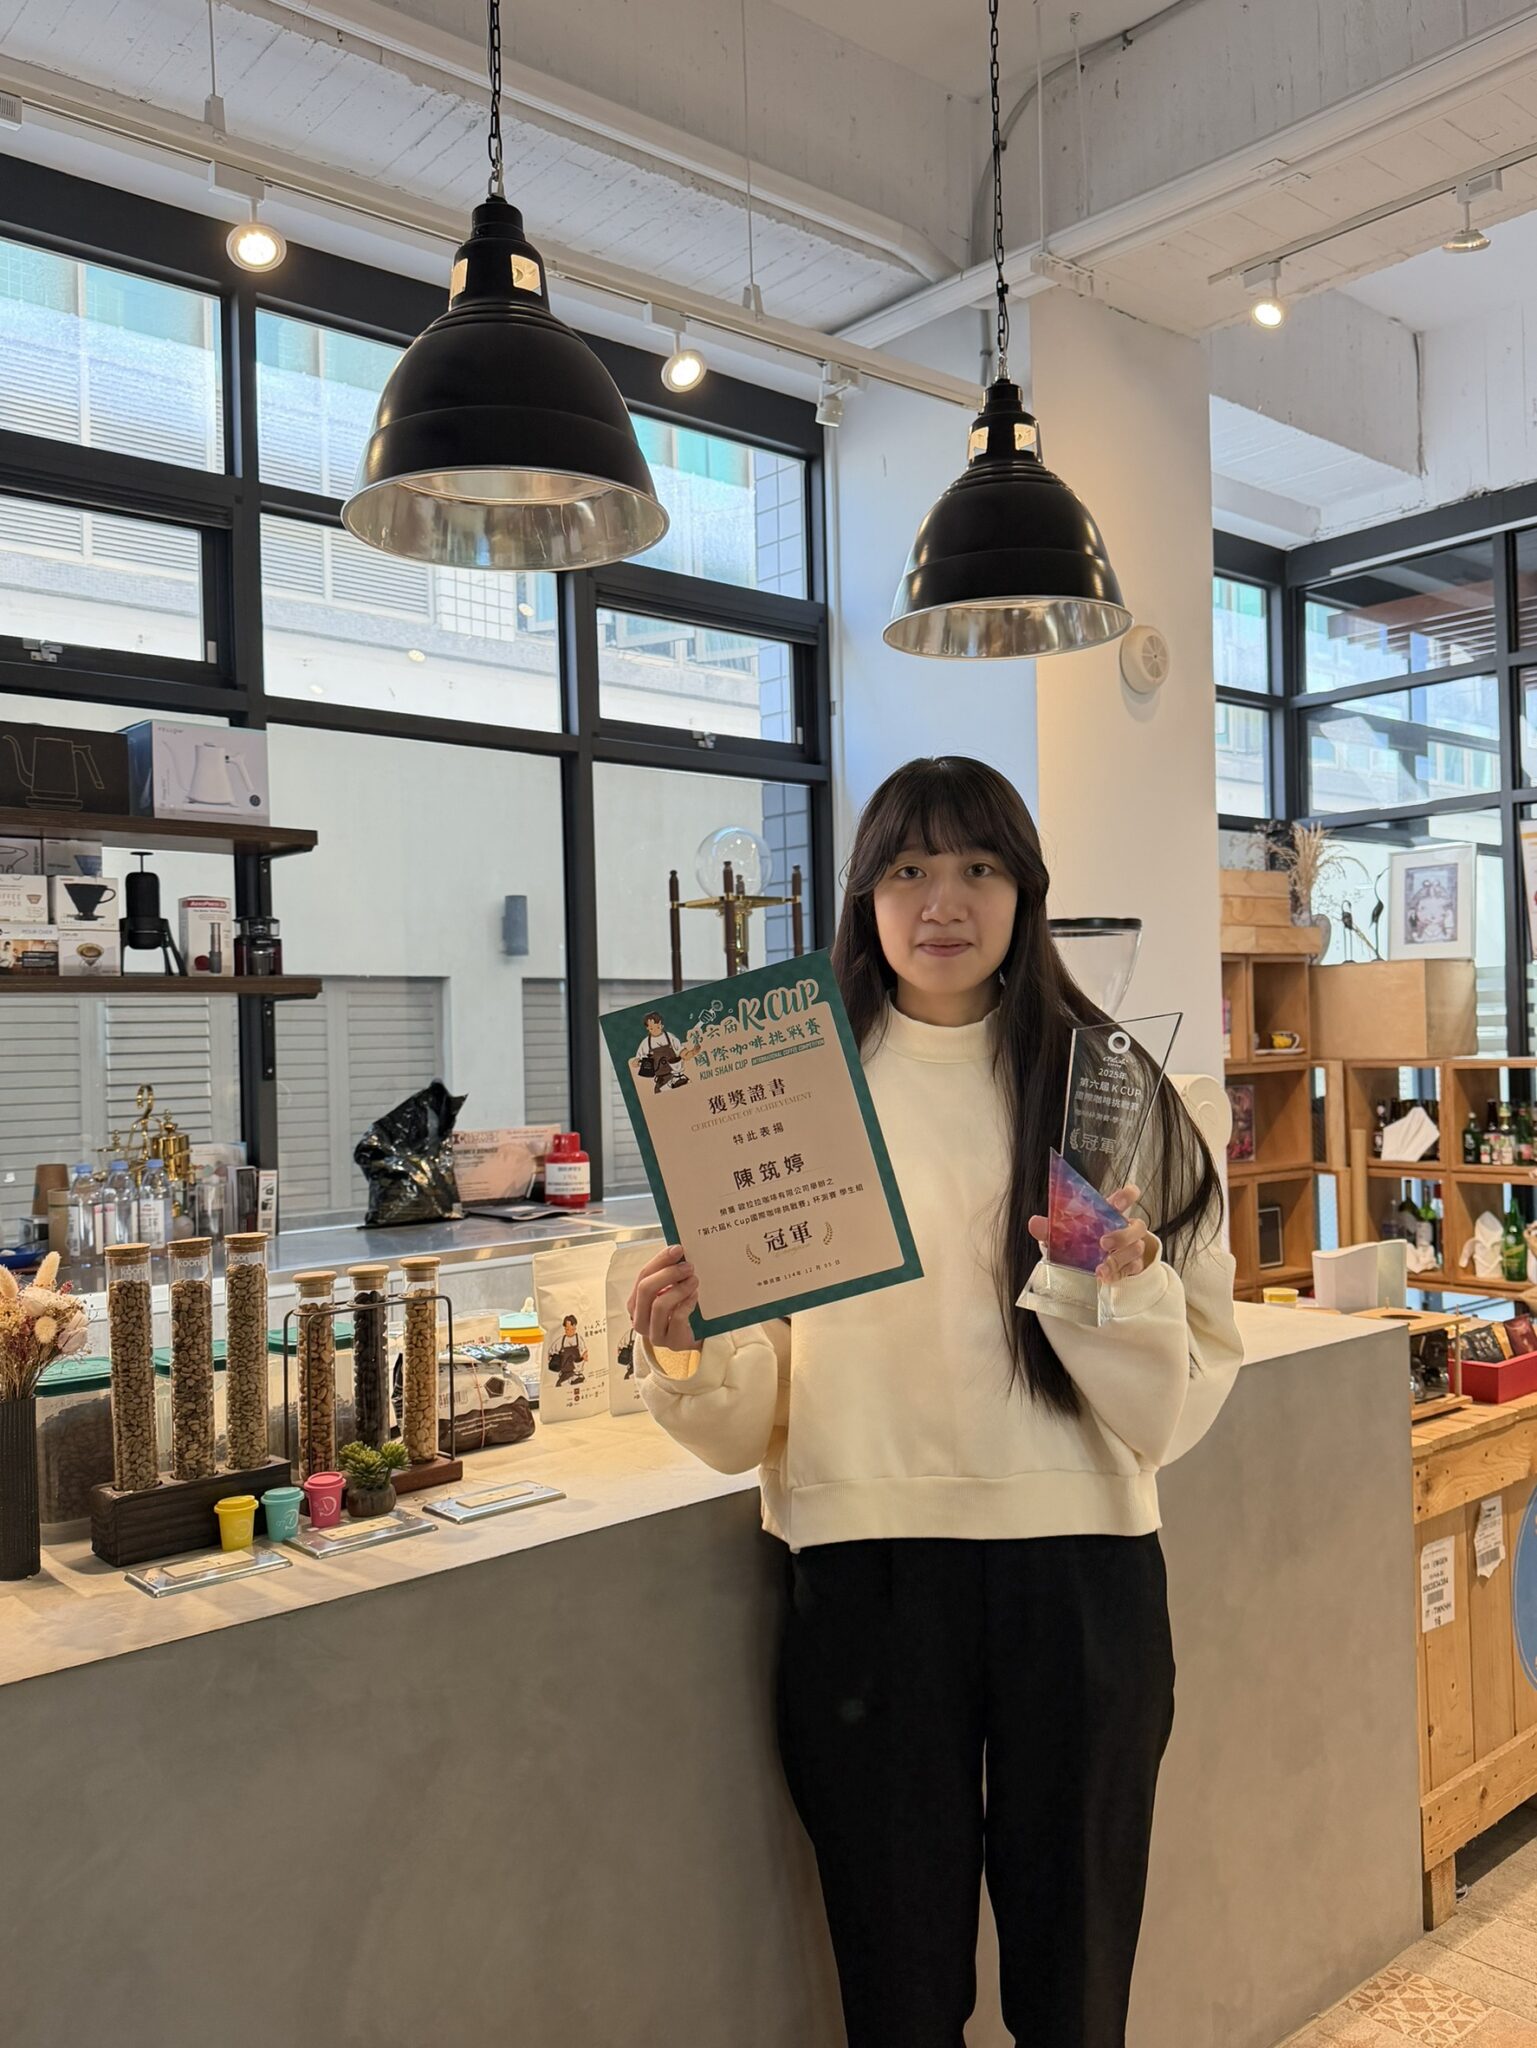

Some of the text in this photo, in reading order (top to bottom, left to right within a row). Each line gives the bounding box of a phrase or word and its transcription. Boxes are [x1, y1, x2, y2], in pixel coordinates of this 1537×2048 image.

[740, 1000, 766, 1031] K
[694, 1017, 822, 1067] 國際咖啡挑戰賽
[700, 1070, 714, 1081] KUN
[715, 1064, 734, 1077] SHAN
[735, 1059, 749, 1070] CUP
[1097, 1067, 1127, 1080] 2025年
[709, 1077, 786, 1115] 獲獎證書
[1079, 1077, 1141, 1098] 第六屆 K CUP
[691, 1091, 813, 1132] CERTIFICATE OF ACHIEVEMENT
[733, 1122, 784, 1145] 特此表揚
[1079, 1133, 1116, 1154] 冠軍
[733, 1153, 805, 1190] 陳筑婷
[762, 1219, 814, 1253] 冠軍
